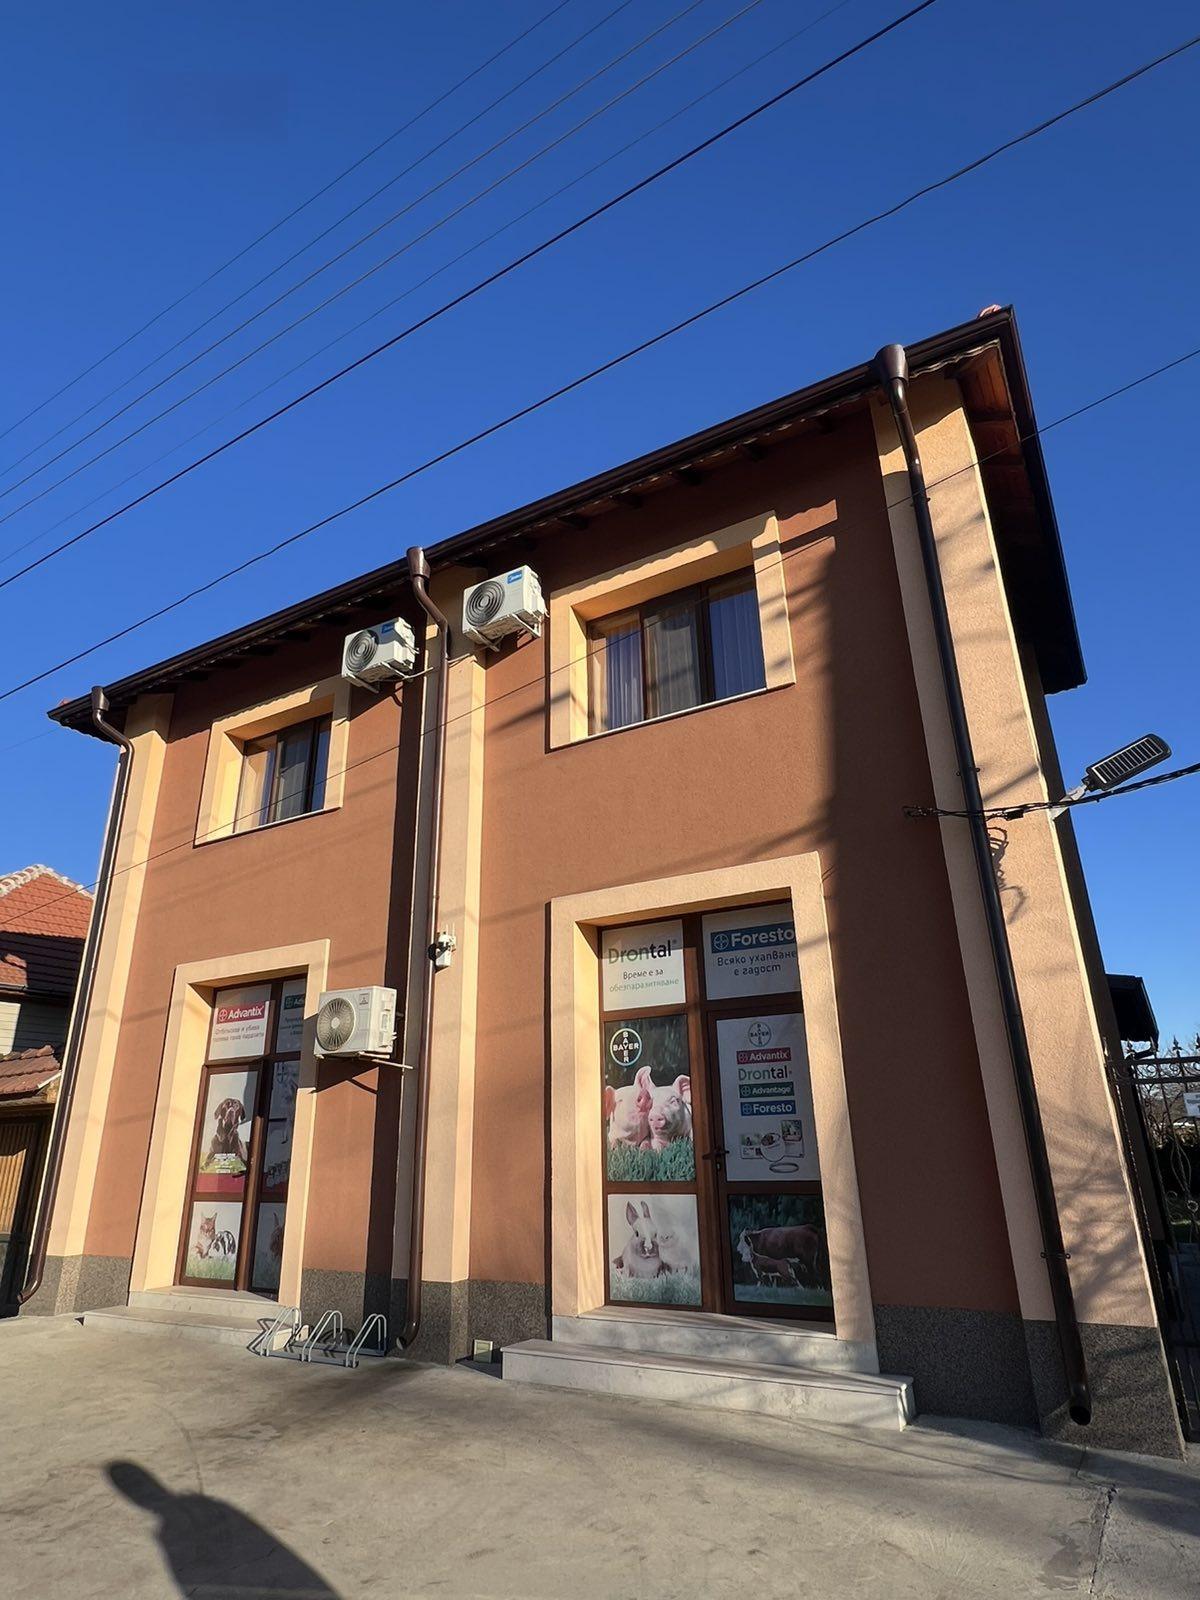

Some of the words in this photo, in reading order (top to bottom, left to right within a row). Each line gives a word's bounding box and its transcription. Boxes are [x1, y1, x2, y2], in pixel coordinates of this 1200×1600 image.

[731, 928, 795, 947] Foresto
[608, 940, 671, 964] Drontal
[717, 956, 746, 966] Всяко
[749, 950, 797, 964] ухапване
[623, 970, 648, 980] Време
[742, 964, 781, 976] гадост
[228, 1006, 264, 1019] Advantix
[613, 1042, 639, 1052] BAYER
[749, 1050, 788, 1061] Advantix
[738, 1066, 788, 1081] Drontal
[752, 1087, 791, 1095] Advantage
[753, 1104, 793, 1114] Foresto
